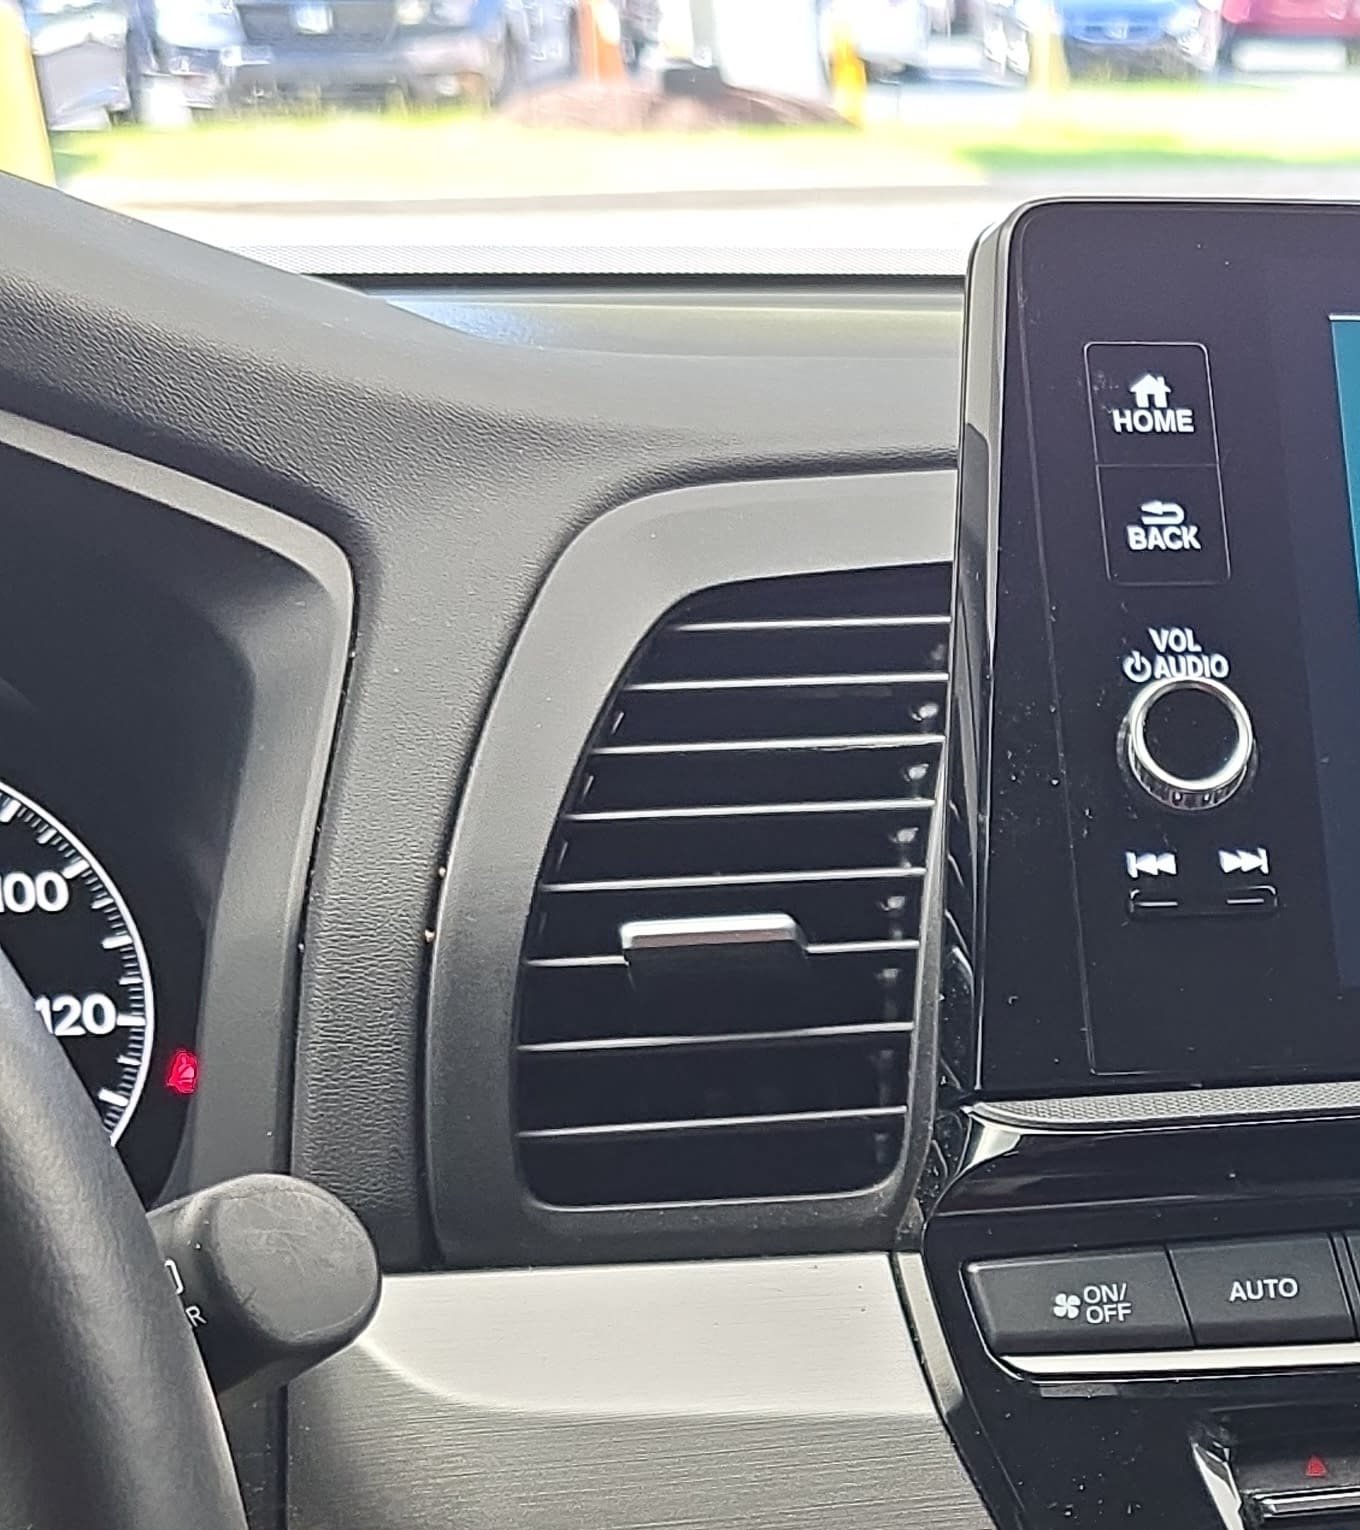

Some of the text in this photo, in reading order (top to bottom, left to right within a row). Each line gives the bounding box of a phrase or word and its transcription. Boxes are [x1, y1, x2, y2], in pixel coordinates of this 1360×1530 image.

[1112, 409, 1194, 434] HOME
[1127, 525, 1201, 551] BACK
[1150, 628, 1201, 652] VOL
[1154, 654, 1229, 679] AUDIO
[0, 871, 70, 913] 00
[34, 993, 116, 1036] 120
[1083, 1282, 1127, 1307] ON/
[1229, 1278, 1299, 1303] AUTO
[1085, 1300, 1133, 1325] OFF
